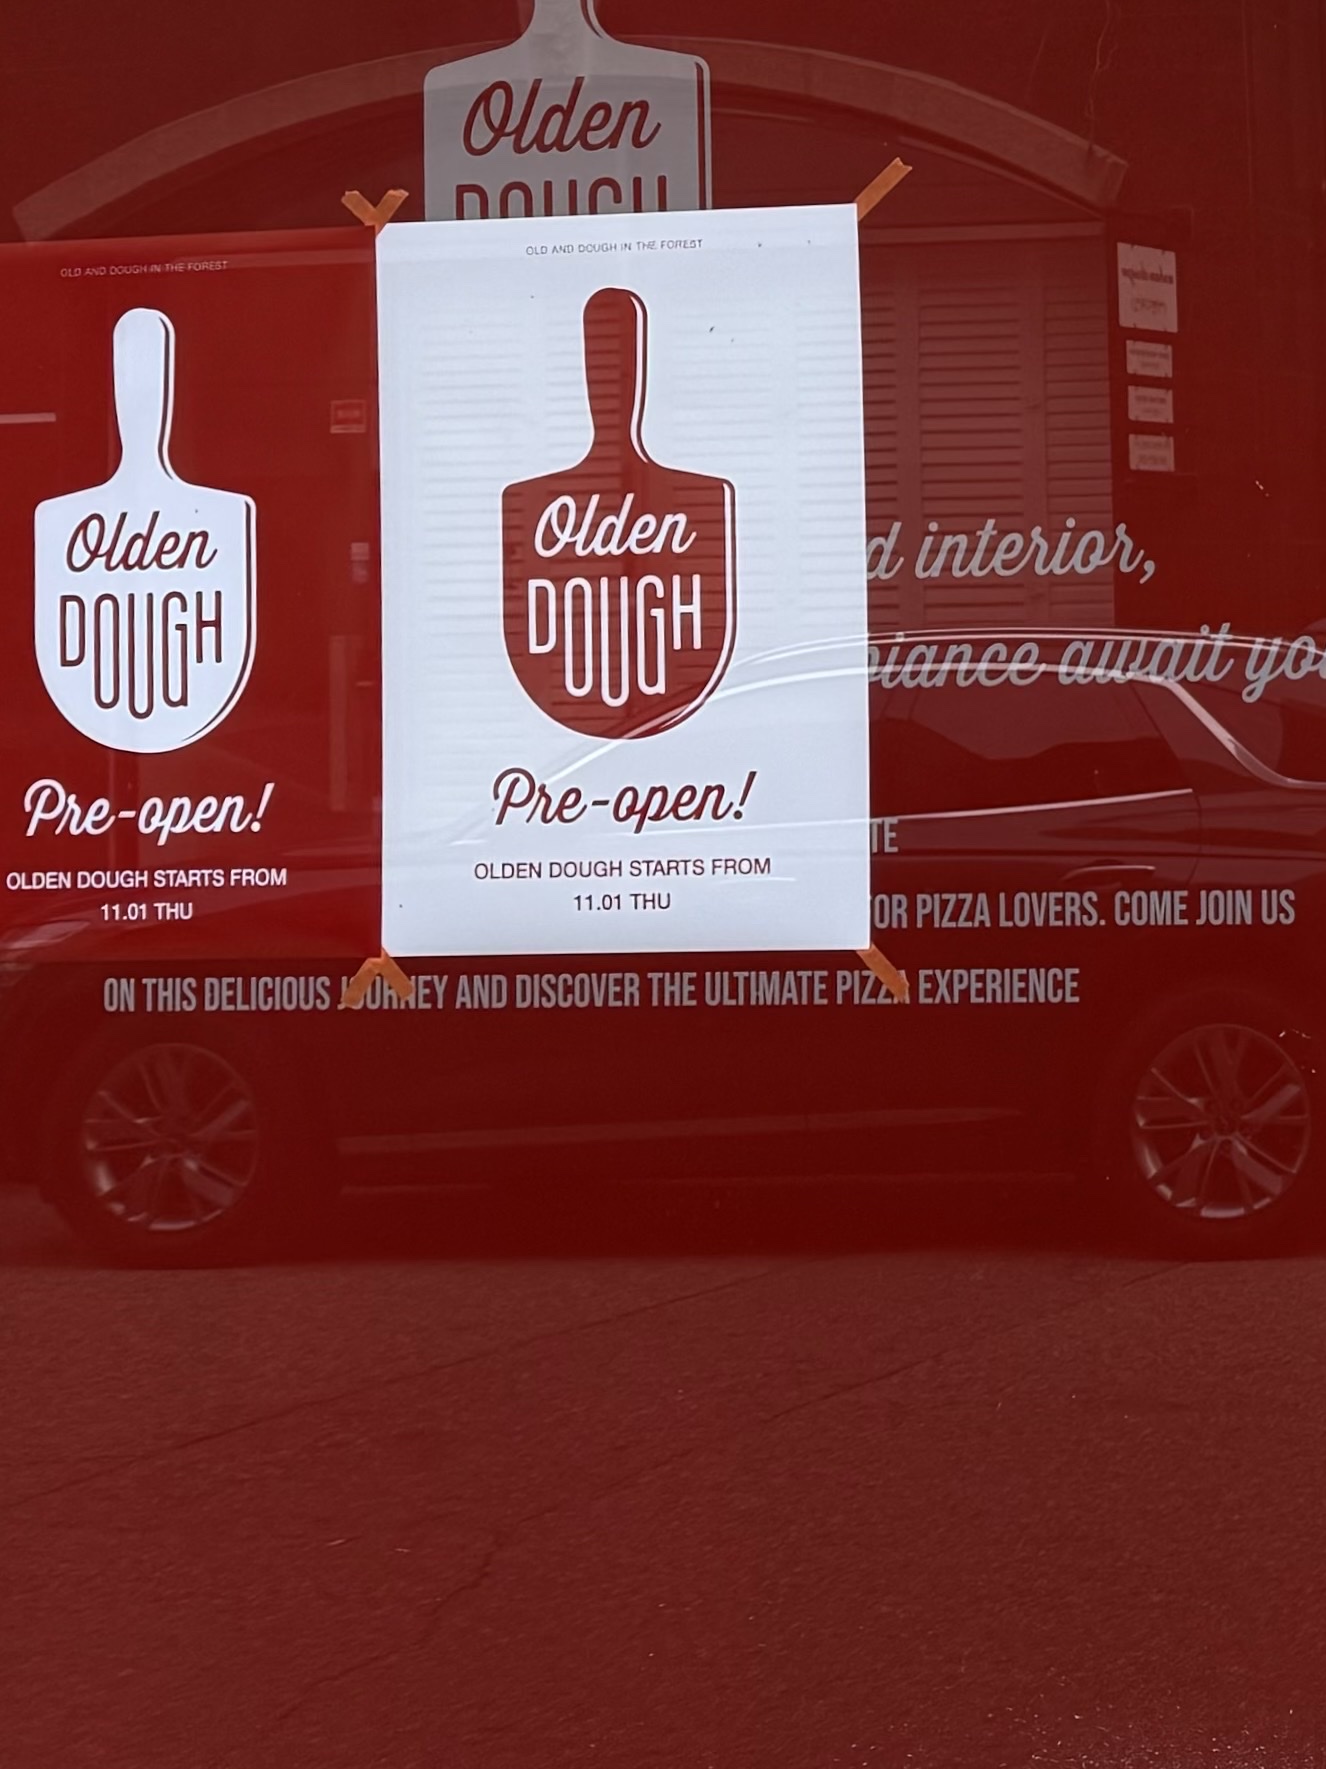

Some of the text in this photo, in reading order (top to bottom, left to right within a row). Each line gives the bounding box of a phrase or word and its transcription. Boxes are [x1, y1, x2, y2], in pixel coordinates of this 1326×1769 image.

[463, 76, 661, 156] Olden
[60, 260, 229, 278] OLD AND DOUGH IN THE FOREST
[526, 238, 704, 256] OLD AND DOUGH IN THE FOREST
[66, 510, 218, 573] Olden
[534, 492, 698, 558] Olden
[914, 517, 1157, 584] interior,
[59, 590, 222, 720] DOUGH
[527, 573, 702, 708] DOUGH
[1058, 621, 1235, 686] await
[23, 778, 276, 846] Pre-open!
[493, 767, 758, 834] Pre-open!
[6, 867, 288, 891] OLDEN DOUGH STARTS FROM
[474, 858, 771, 880] OLDEN DOUGH STARTS FROM
[100, 901, 194, 921] 11.01 THU
[573, 892, 672, 912] 11.01 THU
[870, 888, 1296, 929] OR PIZZA LOVERS. COME JOIN US
[103, 977, 135, 1012] ON
[142, 977, 197, 1012] THIS
[204, 975, 331, 1012] DELICIOUS
[455, 974, 508, 1009] AND
[515, 972, 640, 1008] DISCOVER
[647, 971, 698, 1007] THE
[704, 970, 829, 1006] ULTIMATE
[918, 967, 1081, 1004] EXPERIENCE
